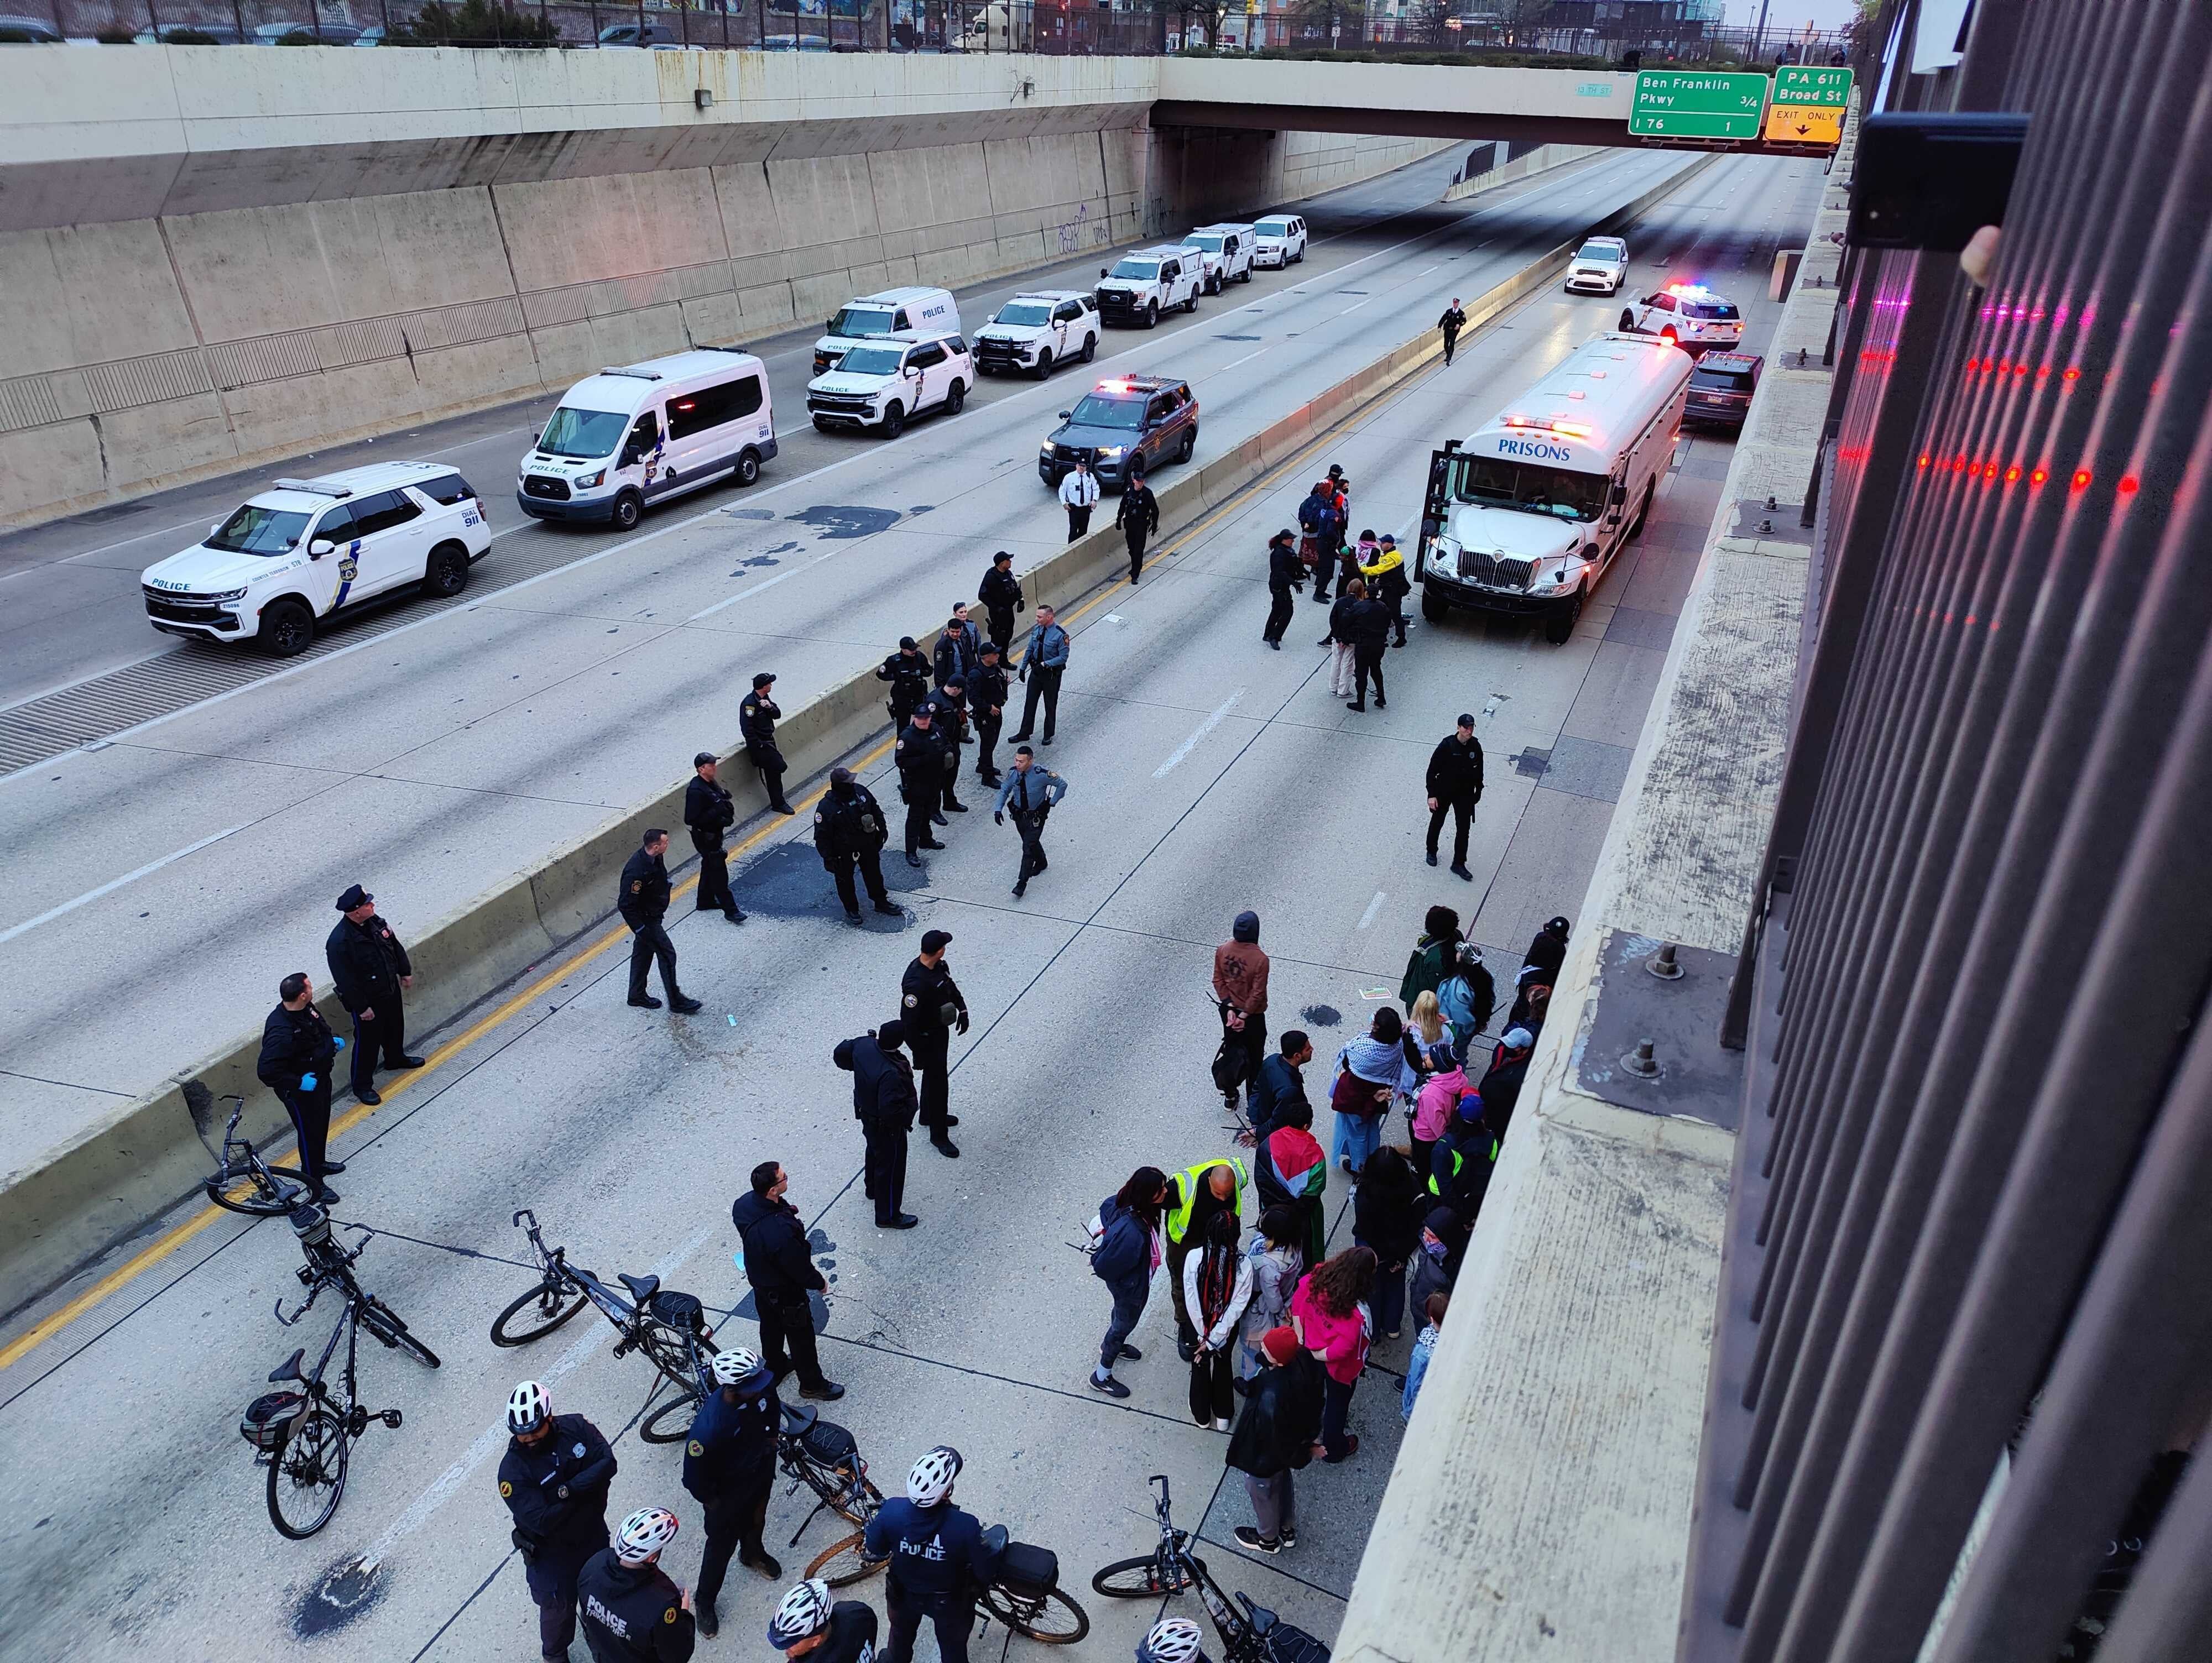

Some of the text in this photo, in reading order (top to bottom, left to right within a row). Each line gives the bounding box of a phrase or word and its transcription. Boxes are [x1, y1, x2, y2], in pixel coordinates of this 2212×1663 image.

[1642, 77, 1730, 90] Ben Franklin
[1788, 72, 1841, 85] PA 611
[1640, 93, 1757, 108] Pkwy 3/4
[1779, 88, 1841, 101] Broad St
[1776, 111, 1835, 121] EXIT ONLY
[1647, 119, 1664, 129] 76
[1725, 121, 1730, 132] 1
[922, 305, 946, 319] POLICE
[759, 428, 769, 438] 911
[1498, 439, 1571, 461] PRISONS
[529, 464, 571, 474] POLICE
[462, 509, 477, 518] DIAL
[465, 515, 479, 527] 911
[152, 578, 192, 590] POLICE
[587, 1594, 628, 1633] POLICE
